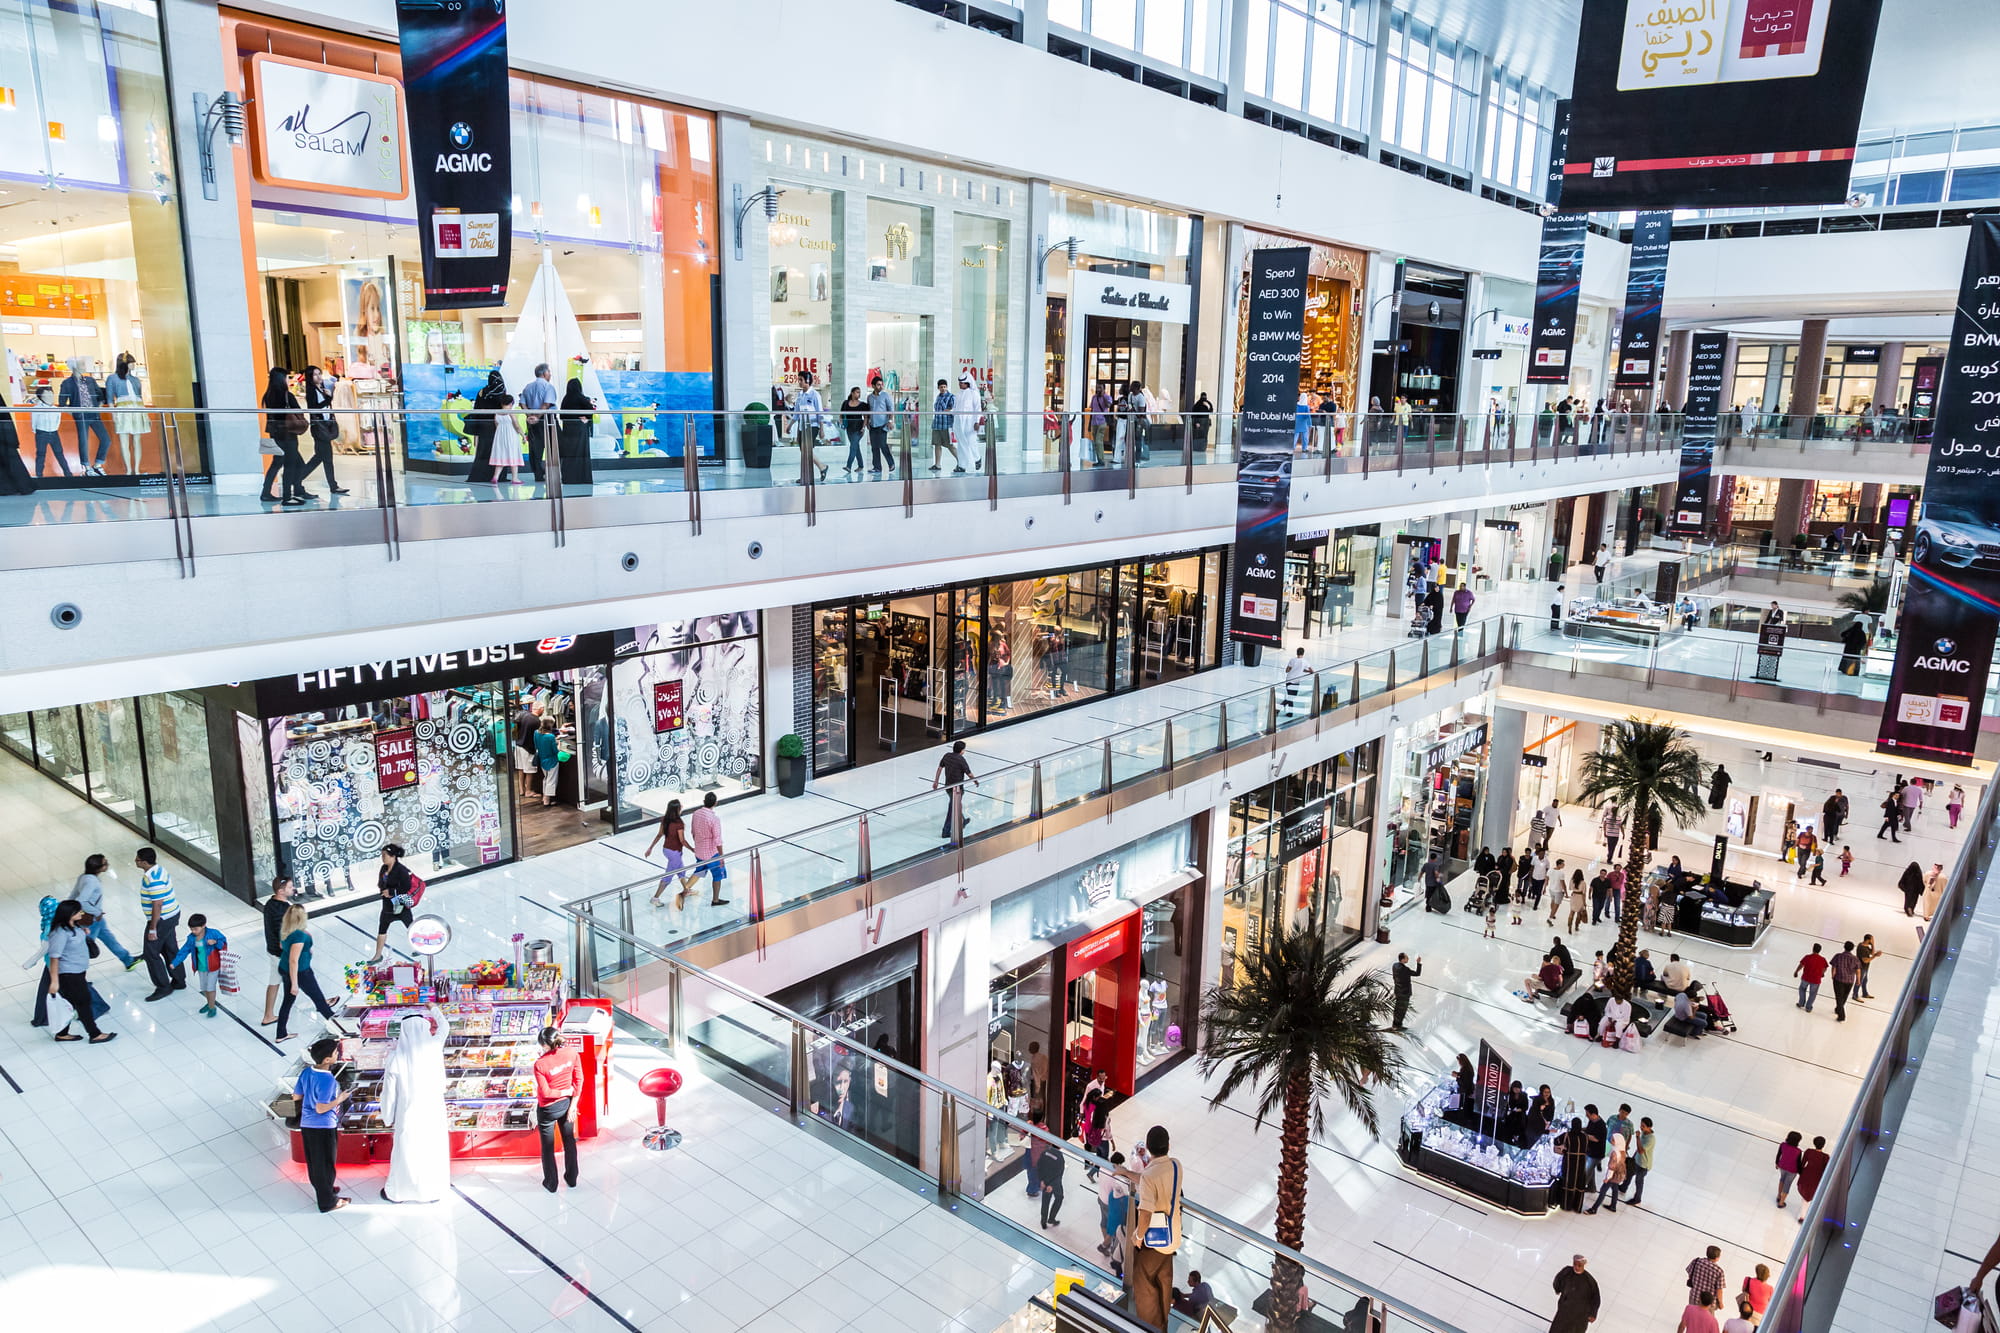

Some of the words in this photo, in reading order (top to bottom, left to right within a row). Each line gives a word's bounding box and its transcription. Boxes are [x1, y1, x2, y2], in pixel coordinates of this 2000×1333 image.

[1750, 9, 1793, 21] دبي
[1641, 29, 1712, 78] دبي
[435, 153, 492, 173] AGMC
[799, 237, 837, 251] Castle
[1265, 268, 1296, 280] Spend
[1259, 289, 1279, 299] AED
[1281, 288, 1300, 299] 300
[1263, 311, 1272, 319] to
[1275, 309, 1292, 319] Win
[1260, 332, 1284, 340] BMW
[1286, 331, 1300, 340] M6
[1541, 328, 1567, 336] AGMC
[1628, 341, 1650, 349] AGMC
[1249, 352, 1269, 361] Gran
[1272, 350, 1301, 363] Coupé
[784, 356, 817, 373] SALE
[1262, 374, 1284, 383] 2014
[1267, 394, 1277, 402] at
[1971, 391, 2000, 405] 201
[1246, 411, 1260, 420] The
[1261, 412, 1280, 420] Dubai
[1941, 438, 1982, 456] مول
[1246, 567, 1276, 579] AGMC
[297, 652, 458, 692] FIFTYFIVE
[467, 643, 525, 667] DSL
[1913, 655, 1970, 674] AGMC
[379, 739, 413, 757] SALE
[1426, 729, 1483, 769] LONGCHAMP
